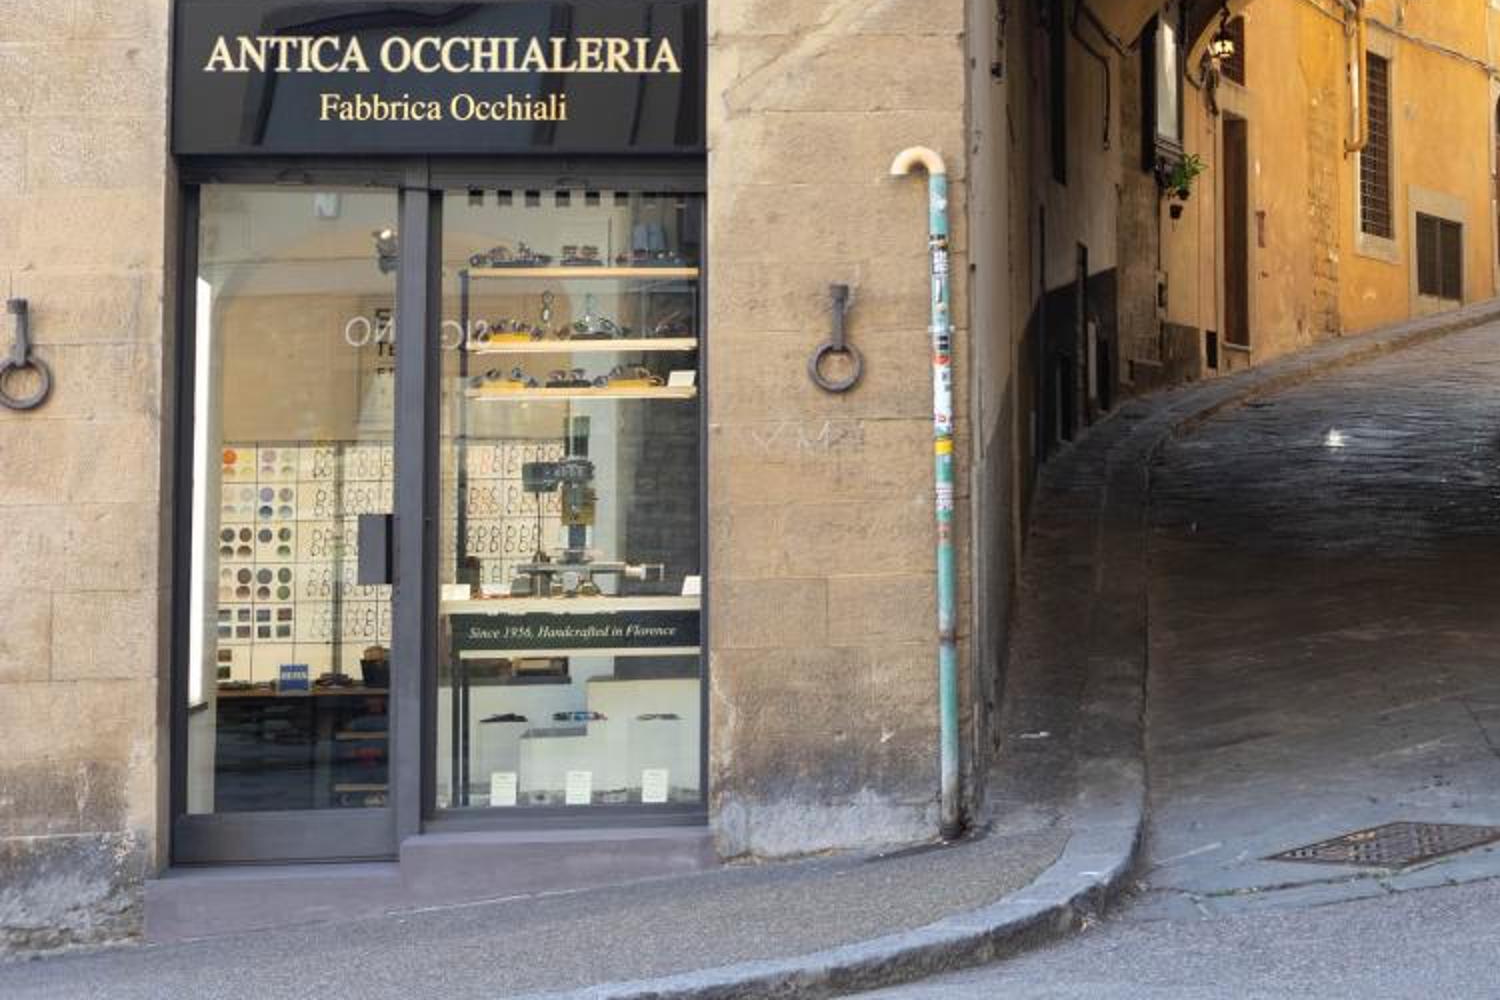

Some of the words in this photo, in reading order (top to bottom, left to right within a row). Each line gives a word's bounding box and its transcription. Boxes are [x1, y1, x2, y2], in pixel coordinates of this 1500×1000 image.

[204, 35, 370, 73] ANTICA
[381, 35, 681, 73] OCCHIALERIA
[319, 93, 442, 121] Fabbrica
[450, 93, 568, 121] Occhiali
[469, 626, 500, 640] Since
[502, 627, 533, 641] 1956,
[537, 625, 610, 640] Handcrafted
[611, 624, 623, 637] in
[625, 623, 678, 637] Florence
